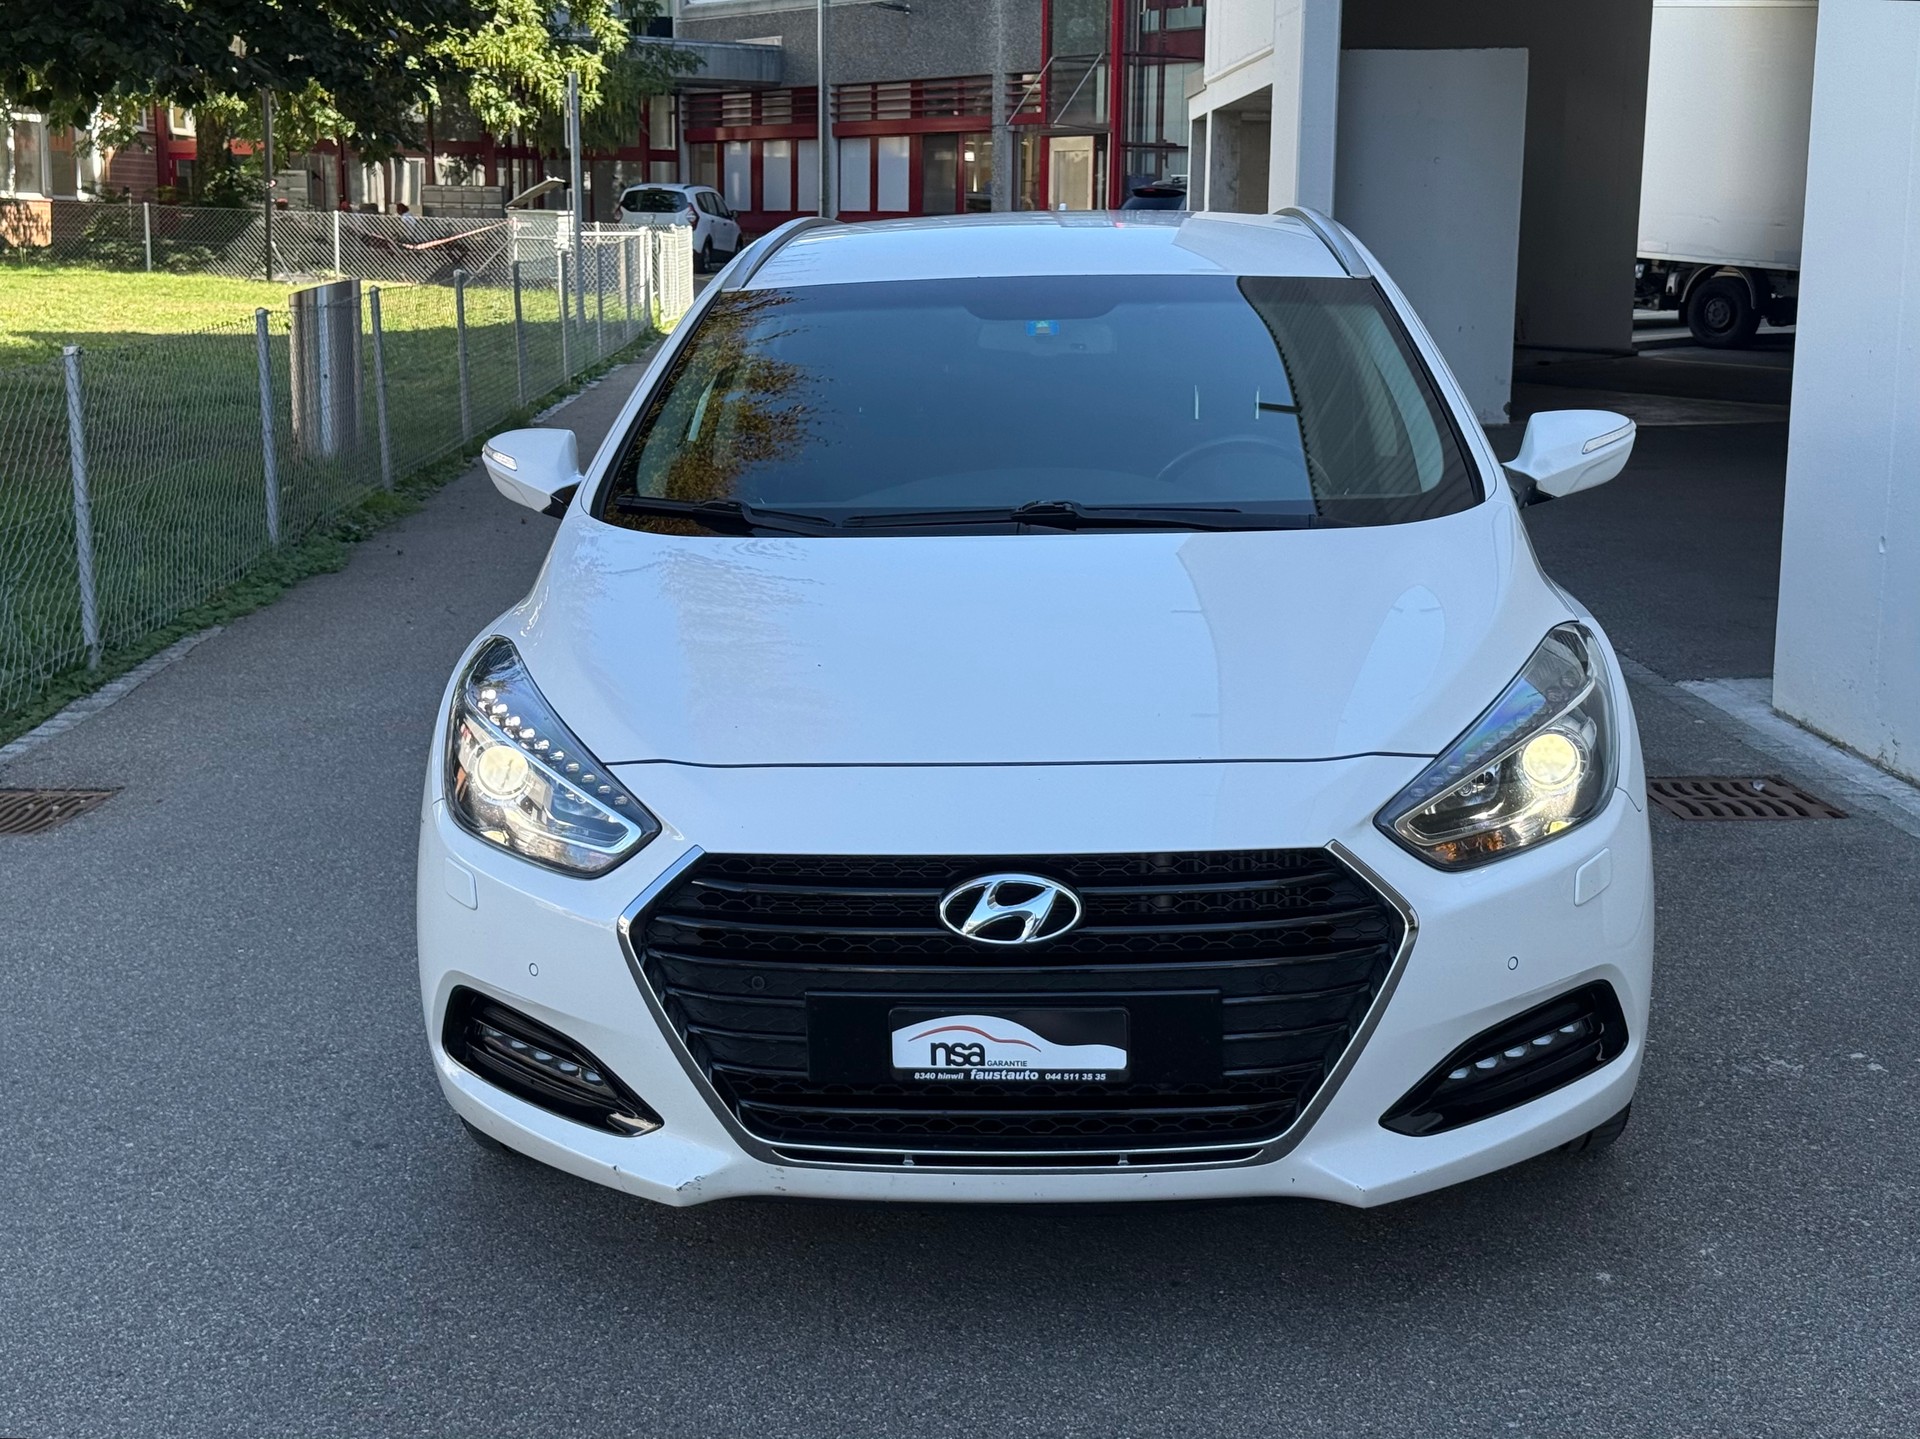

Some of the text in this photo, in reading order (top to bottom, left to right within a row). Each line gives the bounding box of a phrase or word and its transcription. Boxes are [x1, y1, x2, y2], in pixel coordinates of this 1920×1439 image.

[930, 1042, 985, 1066] nsa
[914, 1069, 1106, 1081] 8340 hinwil faustauto 044 511 35 35
